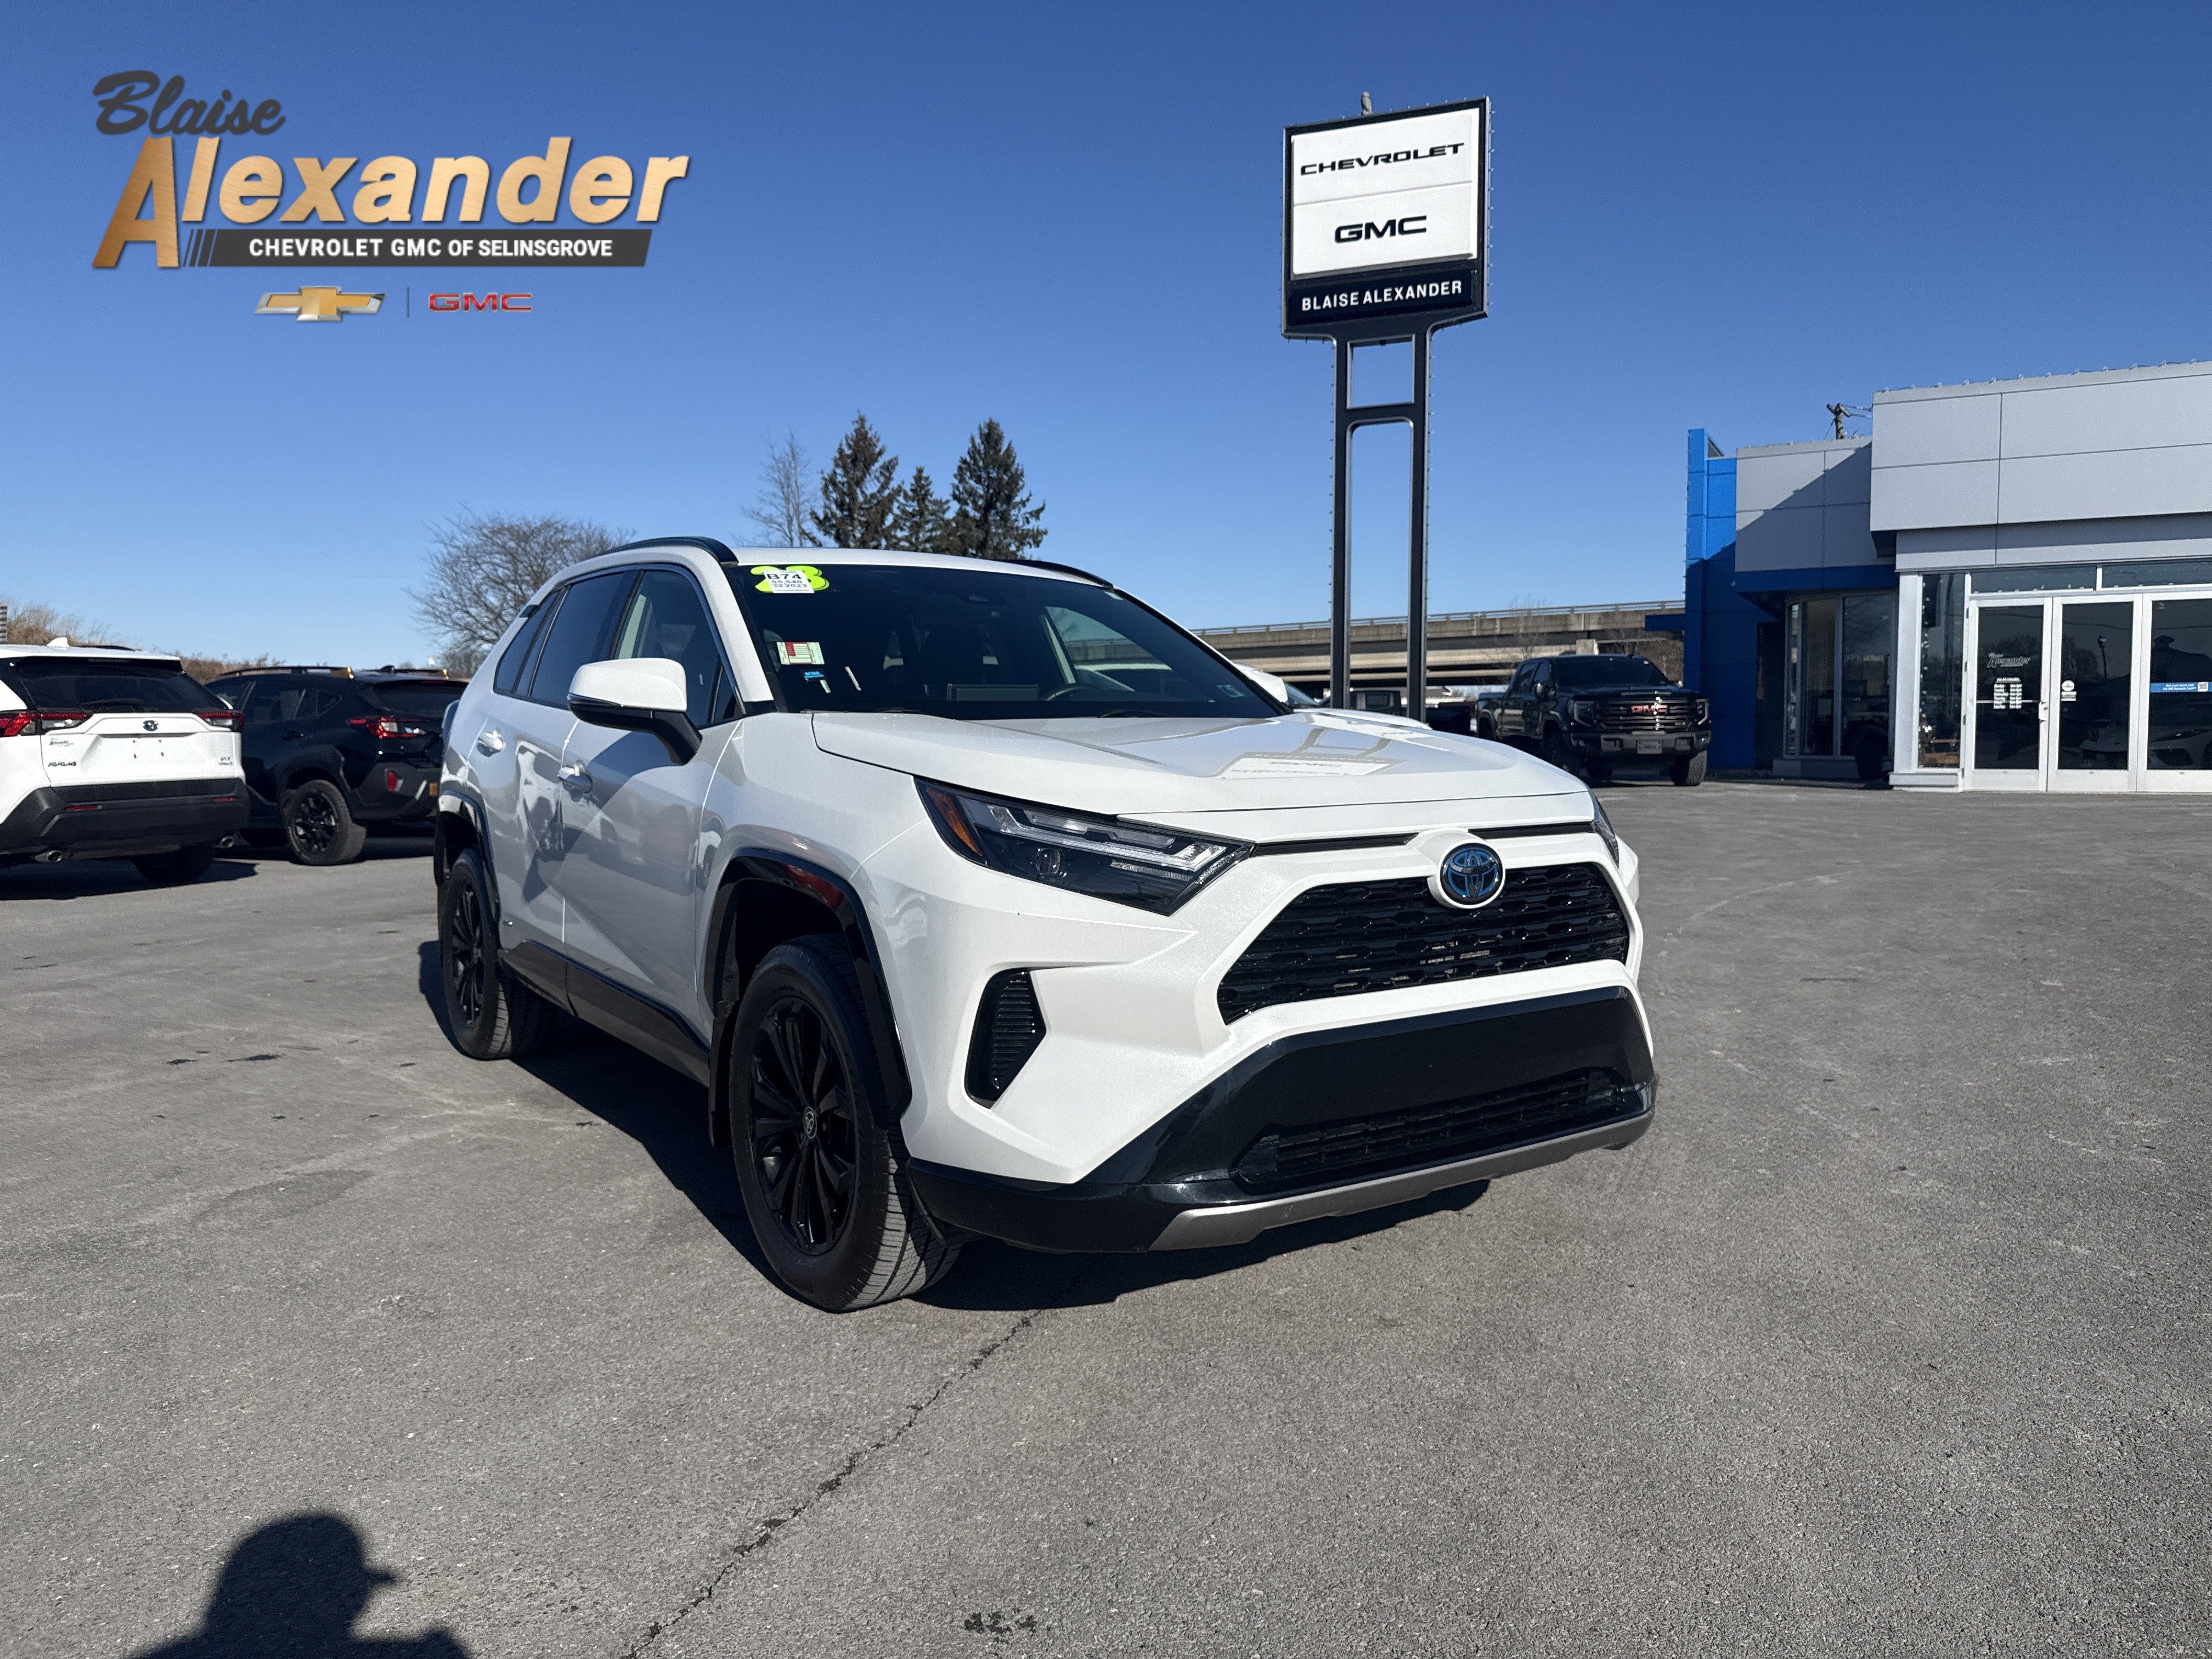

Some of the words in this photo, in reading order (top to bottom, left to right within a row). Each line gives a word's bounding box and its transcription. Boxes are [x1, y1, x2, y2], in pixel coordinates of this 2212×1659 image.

[1300, 143, 1464, 176] CHEVROLET
[1334, 215, 1427, 244] GMC
[1302, 291, 1359, 311] BLAISE
[1363, 280, 1463, 304] ALEXANDER
